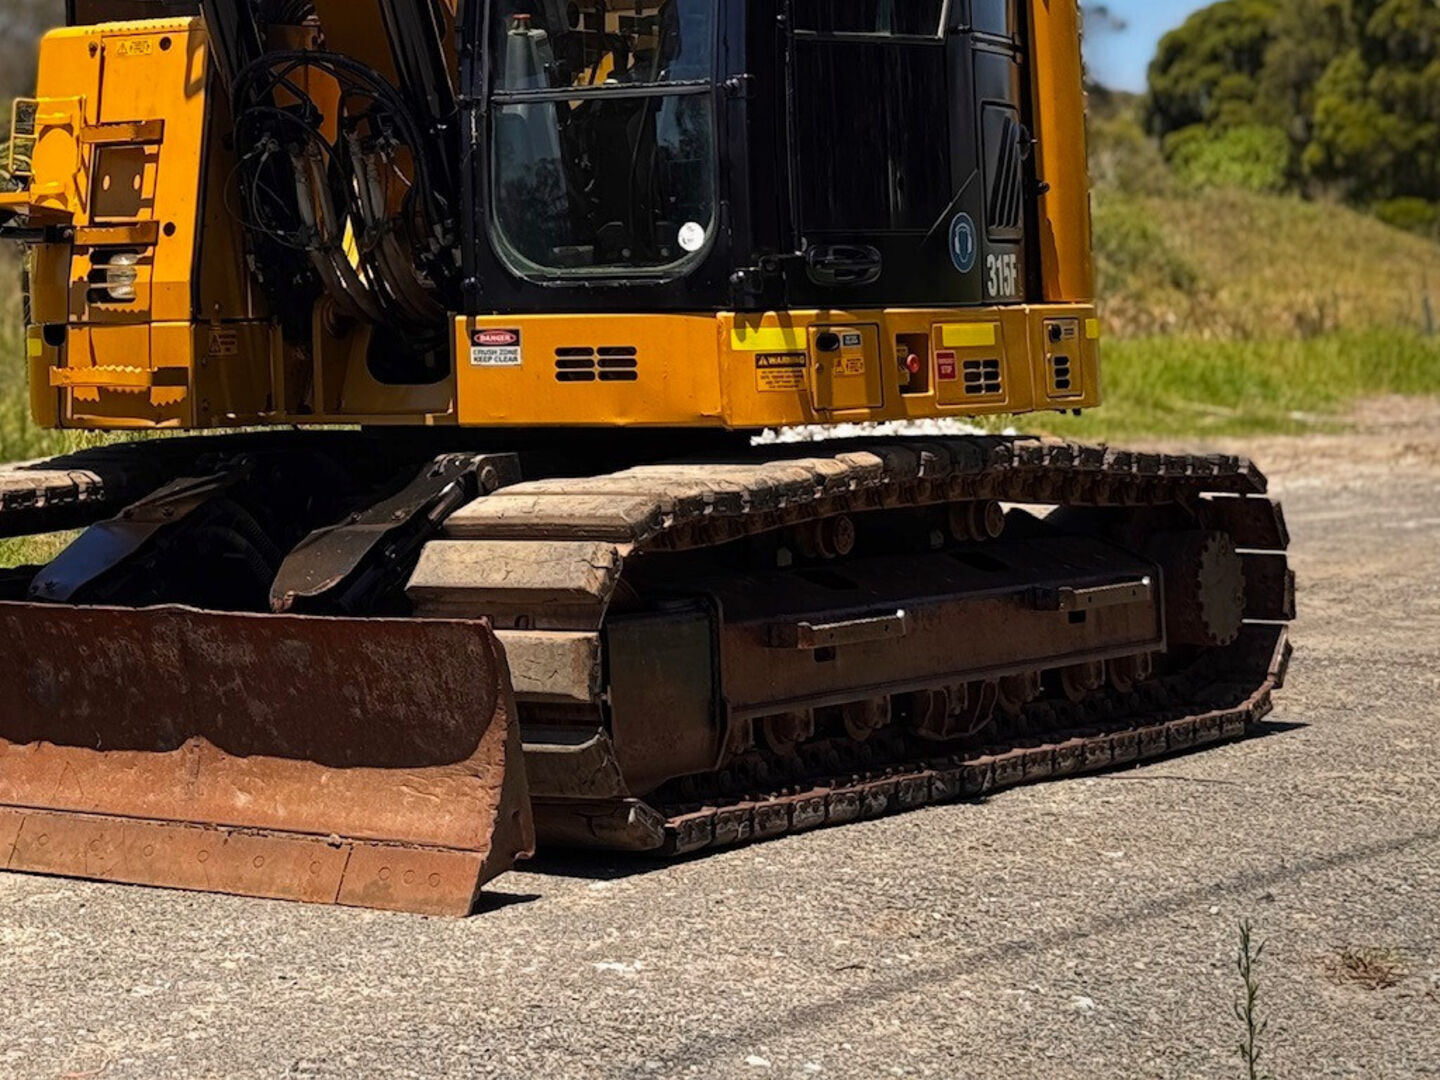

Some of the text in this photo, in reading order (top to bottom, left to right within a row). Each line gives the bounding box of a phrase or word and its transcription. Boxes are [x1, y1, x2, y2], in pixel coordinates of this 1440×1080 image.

[986, 253, 1017, 297] 315F
[478, 333, 511, 343] DANGER
[472, 348, 519, 356] CRUSH ZONE
